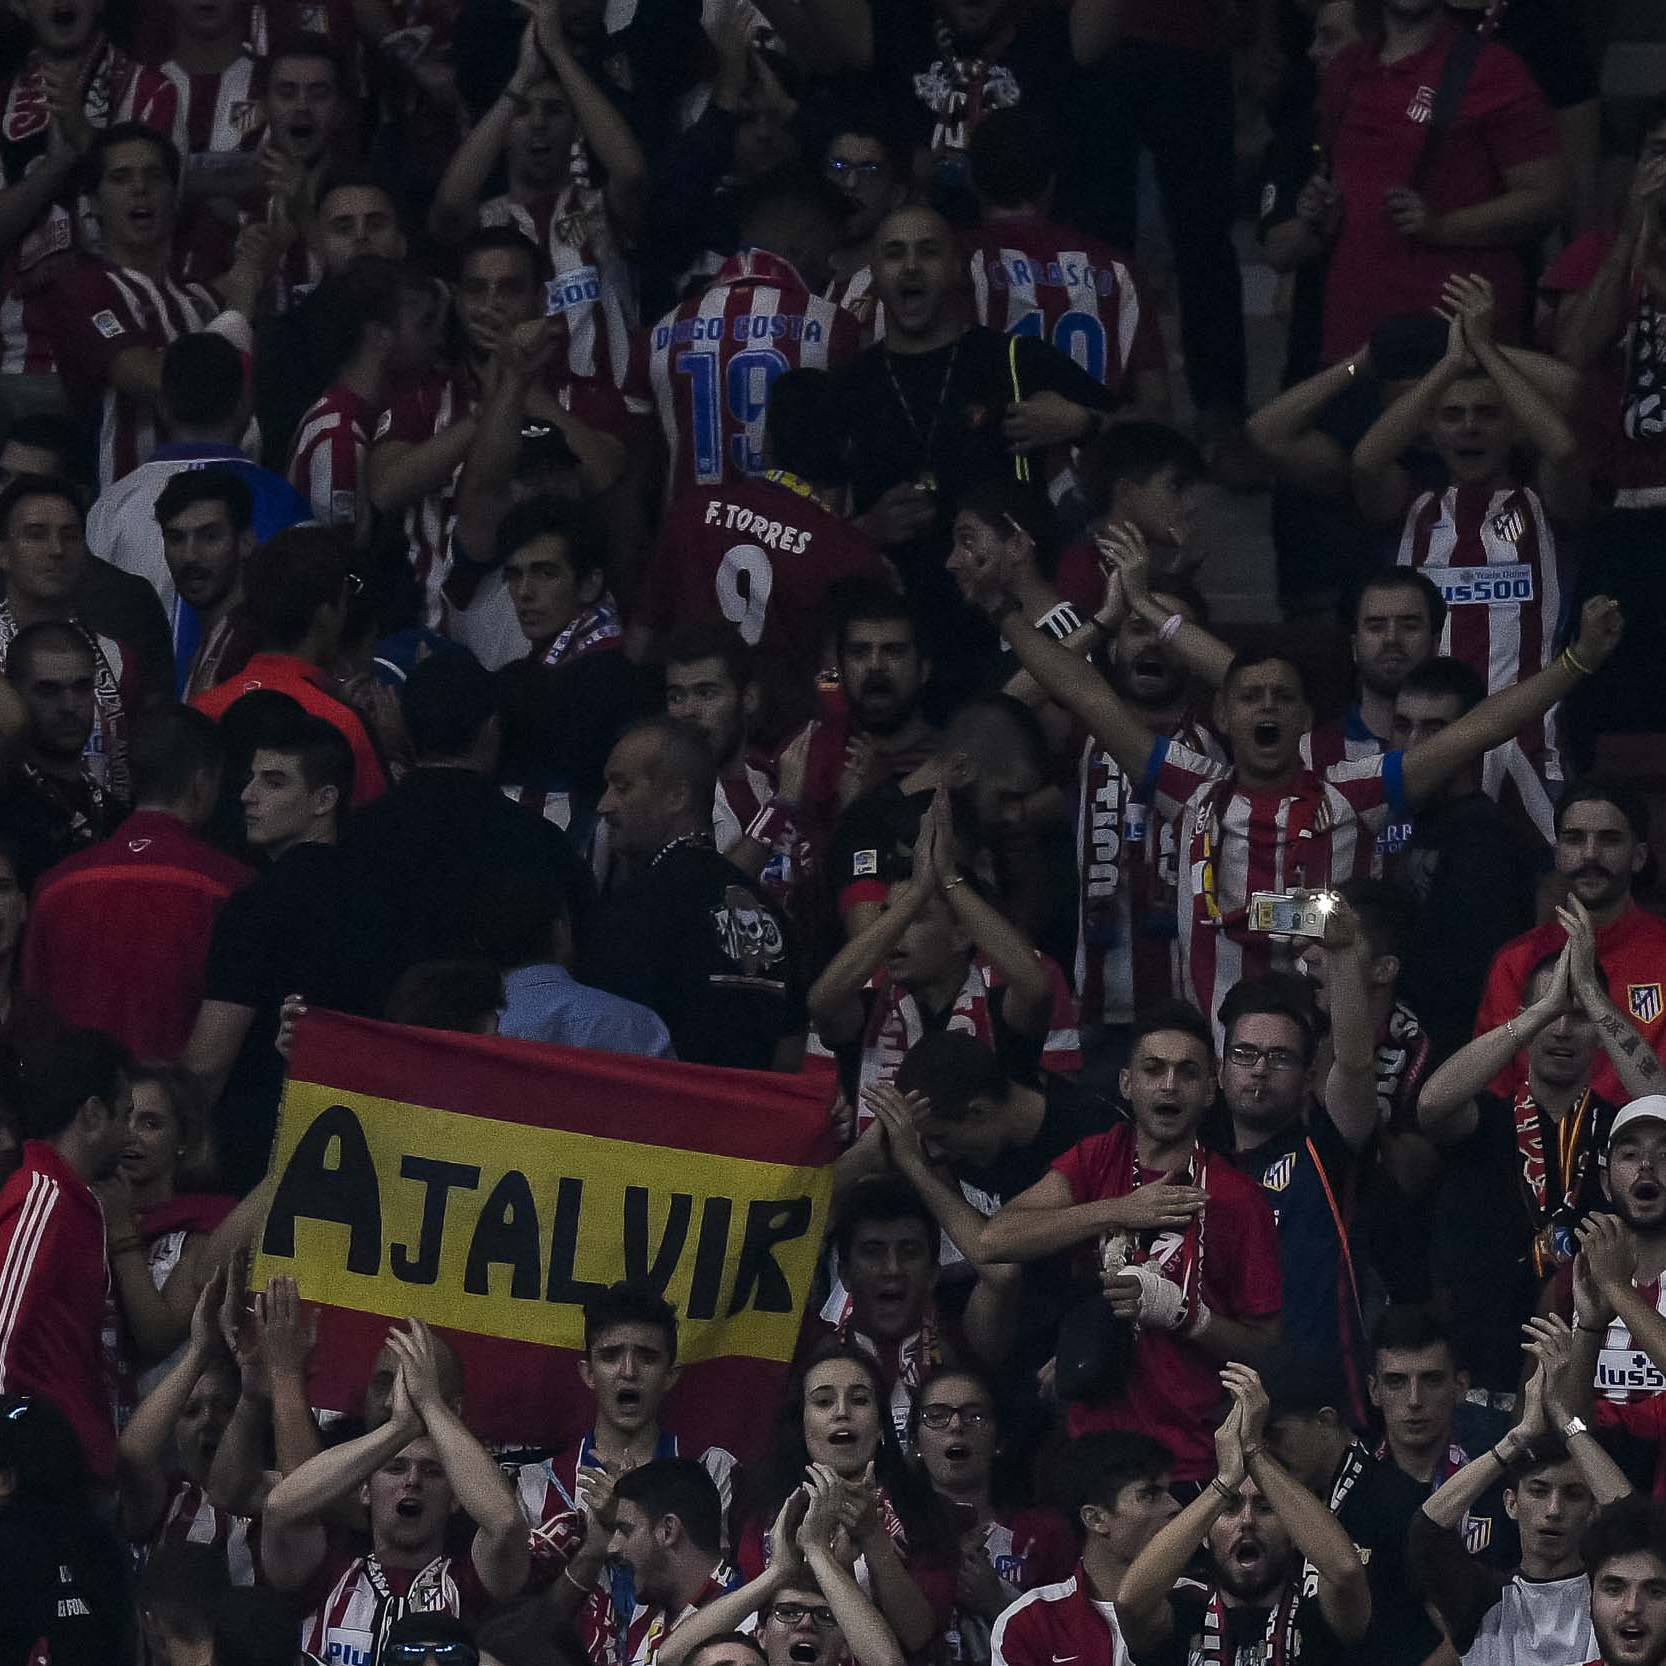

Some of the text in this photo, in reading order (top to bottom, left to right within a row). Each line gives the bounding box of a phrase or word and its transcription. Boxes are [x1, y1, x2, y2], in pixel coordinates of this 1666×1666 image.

[703, 498, 814, 556] F.TORRES
[715, 543, 775, 648] 9
[261, 1105, 813, 1322] AJALVIR
